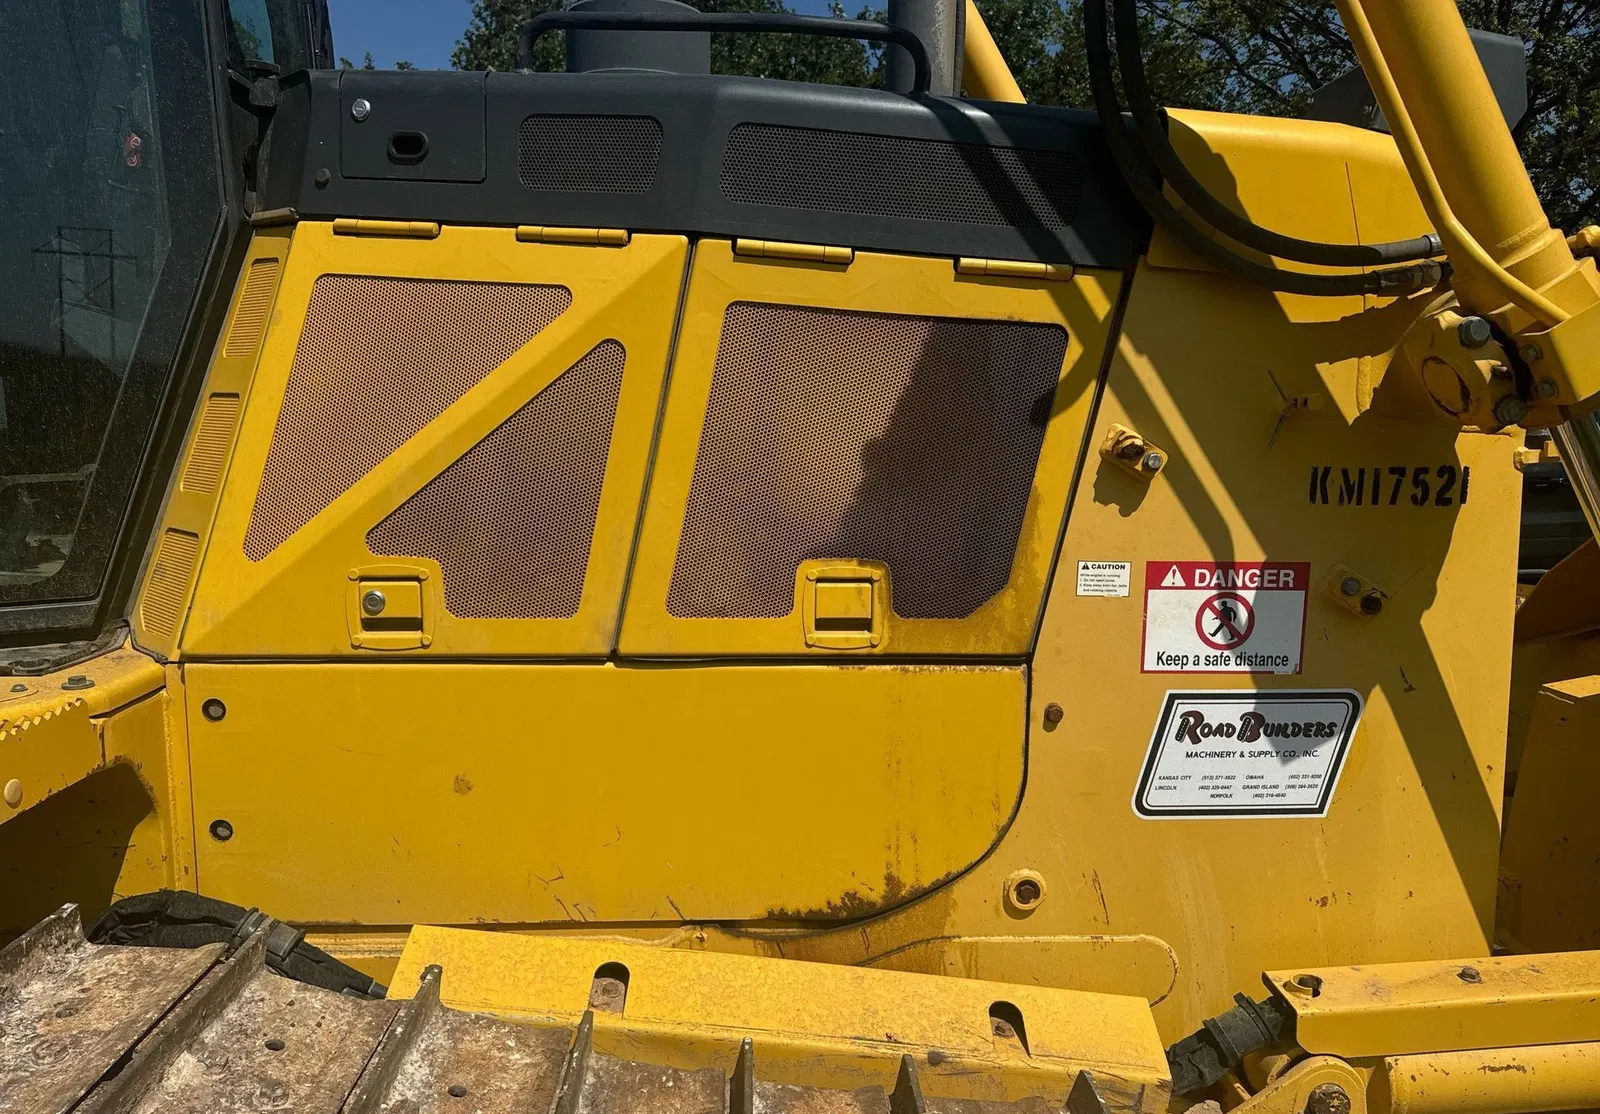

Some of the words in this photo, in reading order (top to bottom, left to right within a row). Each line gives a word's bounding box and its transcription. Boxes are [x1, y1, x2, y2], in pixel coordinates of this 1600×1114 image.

[1194, 569, 1295, 588] DANGER
[1156, 651, 1189, 669] Keep
[1193, 655, 1200, 666] a
[1204, 651, 1230, 666] safe
[1235, 651, 1289, 667] distance
[1175, 710, 1237, 745] ROAD
[1237, 711, 1338, 743] BUILDERS
[1185, 751, 1237, 759] MACHINERY
[1248, 750, 1281, 758] SUPPLY
[1302, 750, 1320, 758] INC.
